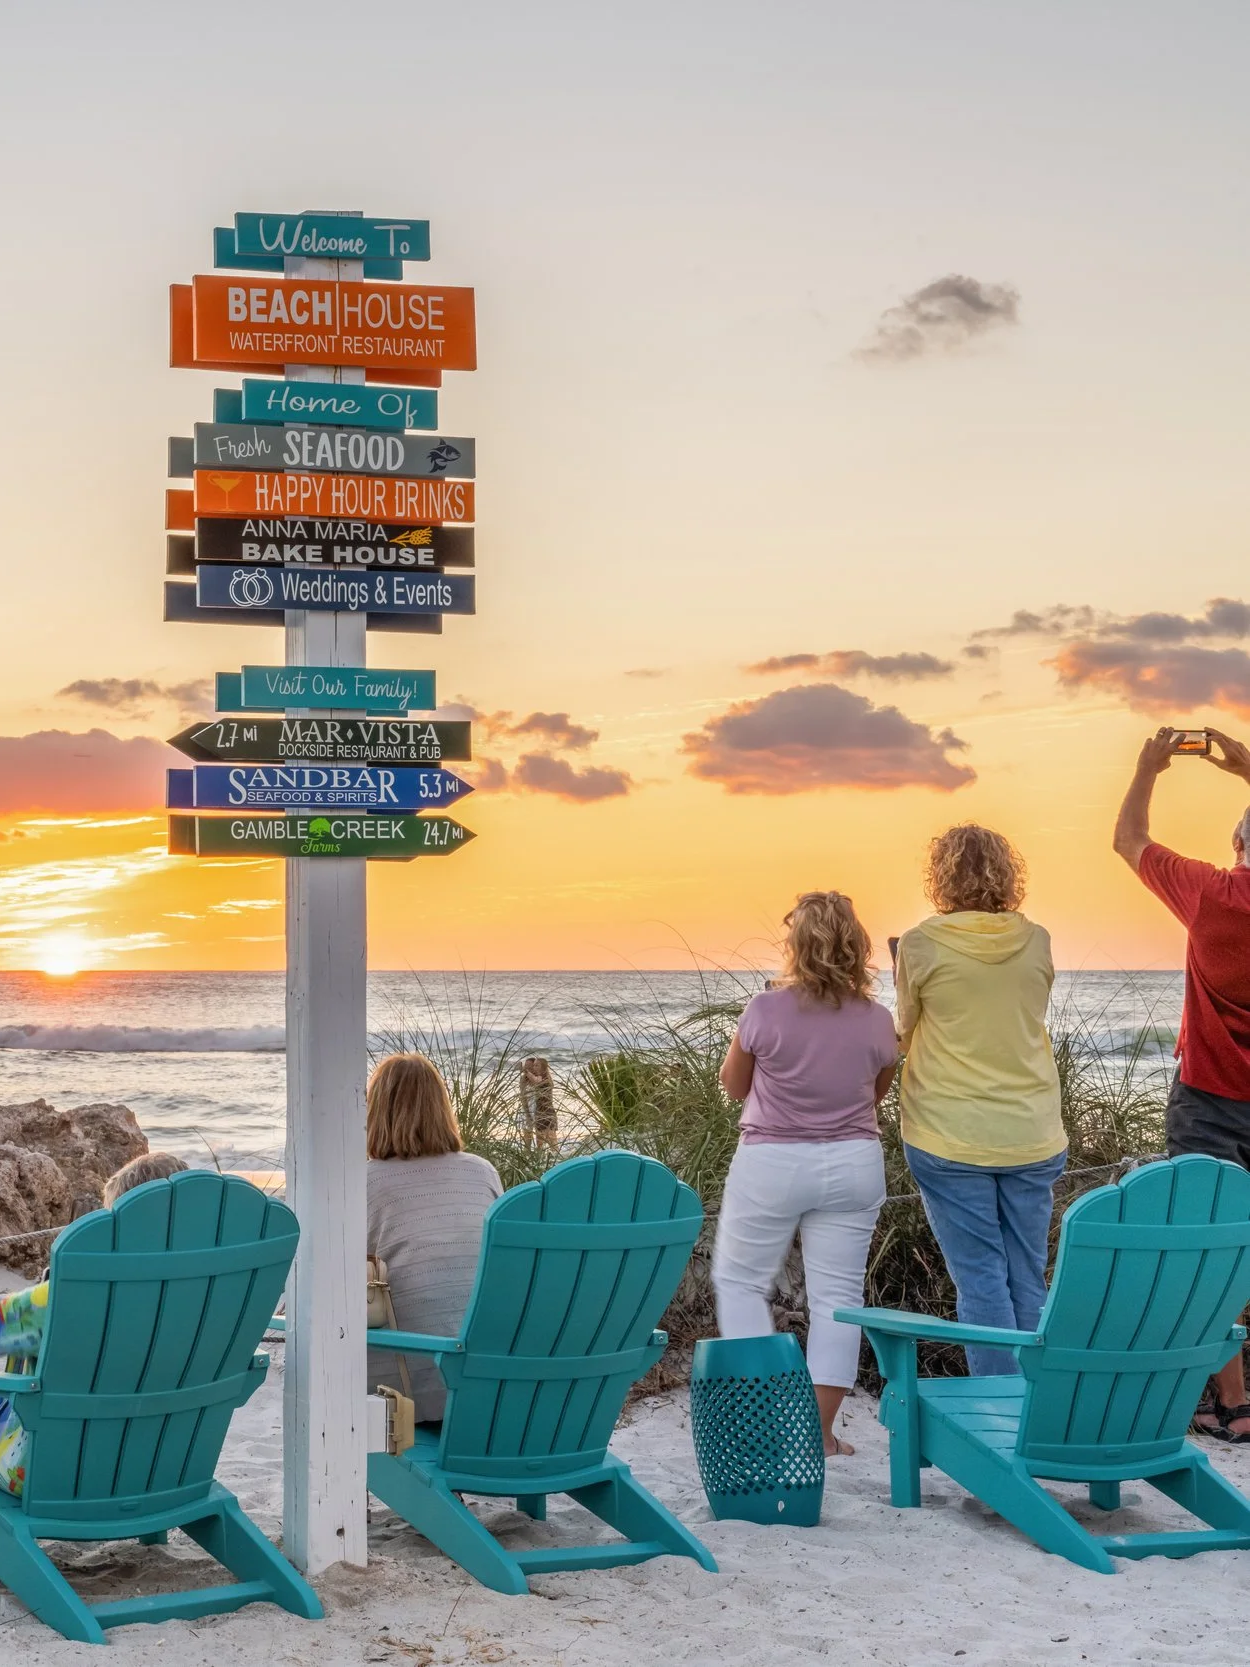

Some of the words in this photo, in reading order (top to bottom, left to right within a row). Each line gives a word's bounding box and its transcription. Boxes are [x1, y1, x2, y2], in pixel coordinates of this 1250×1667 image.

[259, 217, 367, 254] Welcome
[374, 224, 410, 256] To
[228, 287, 332, 325] BEACH
[344, 293, 445, 330] HOUSE
[229, 332, 338, 353] WATERFRONT
[343, 336, 445, 357] RESTAURANT
[267, 386, 361, 414] Home
[378, 393, 417, 429] Of
[213, 427, 271, 462] Fresh
[283, 430, 405, 471] SEAFOOD
[255, 474, 325, 513] HAPPY
[331, 478, 386, 516] HOUR
[394, 481, 465, 519] DRINKS
[242, 519, 308, 539] ANNA
[315, 522, 388, 542] MARIA
[242, 543, 323, 563] BAKE
[333, 546, 435, 565] HOUSE
[280, 572, 369, 611] Weddings
[375, 576, 387, 603] &
[393, 577, 452, 606] Events
[266, 672, 309, 696] Visit
[312, 674, 347, 696] Our
[354, 675, 417, 710] Family!
[216, 723, 239, 748] 2.7
[278, 743, 334, 758] DOCKSIDE
[337, 744, 408, 759] RESTAURANT
[410, 746, 417, 758] &
[420, 747, 441, 759] PUB
[228, 768, 399, 805] SANDBAR
[247, 791, 310, 802] SEAFOOD
[315, 791, 323, 802] &
[327, 792, 377, 803] SPIRITS
[419, 774, 442, 798] 5.3
[231, 820, 309, 840] GAMBLE
[330, 820, 405, 840] CREEK
[423, 821, 450, 845] 24.7
[301, 838, 340, 854] Farms
